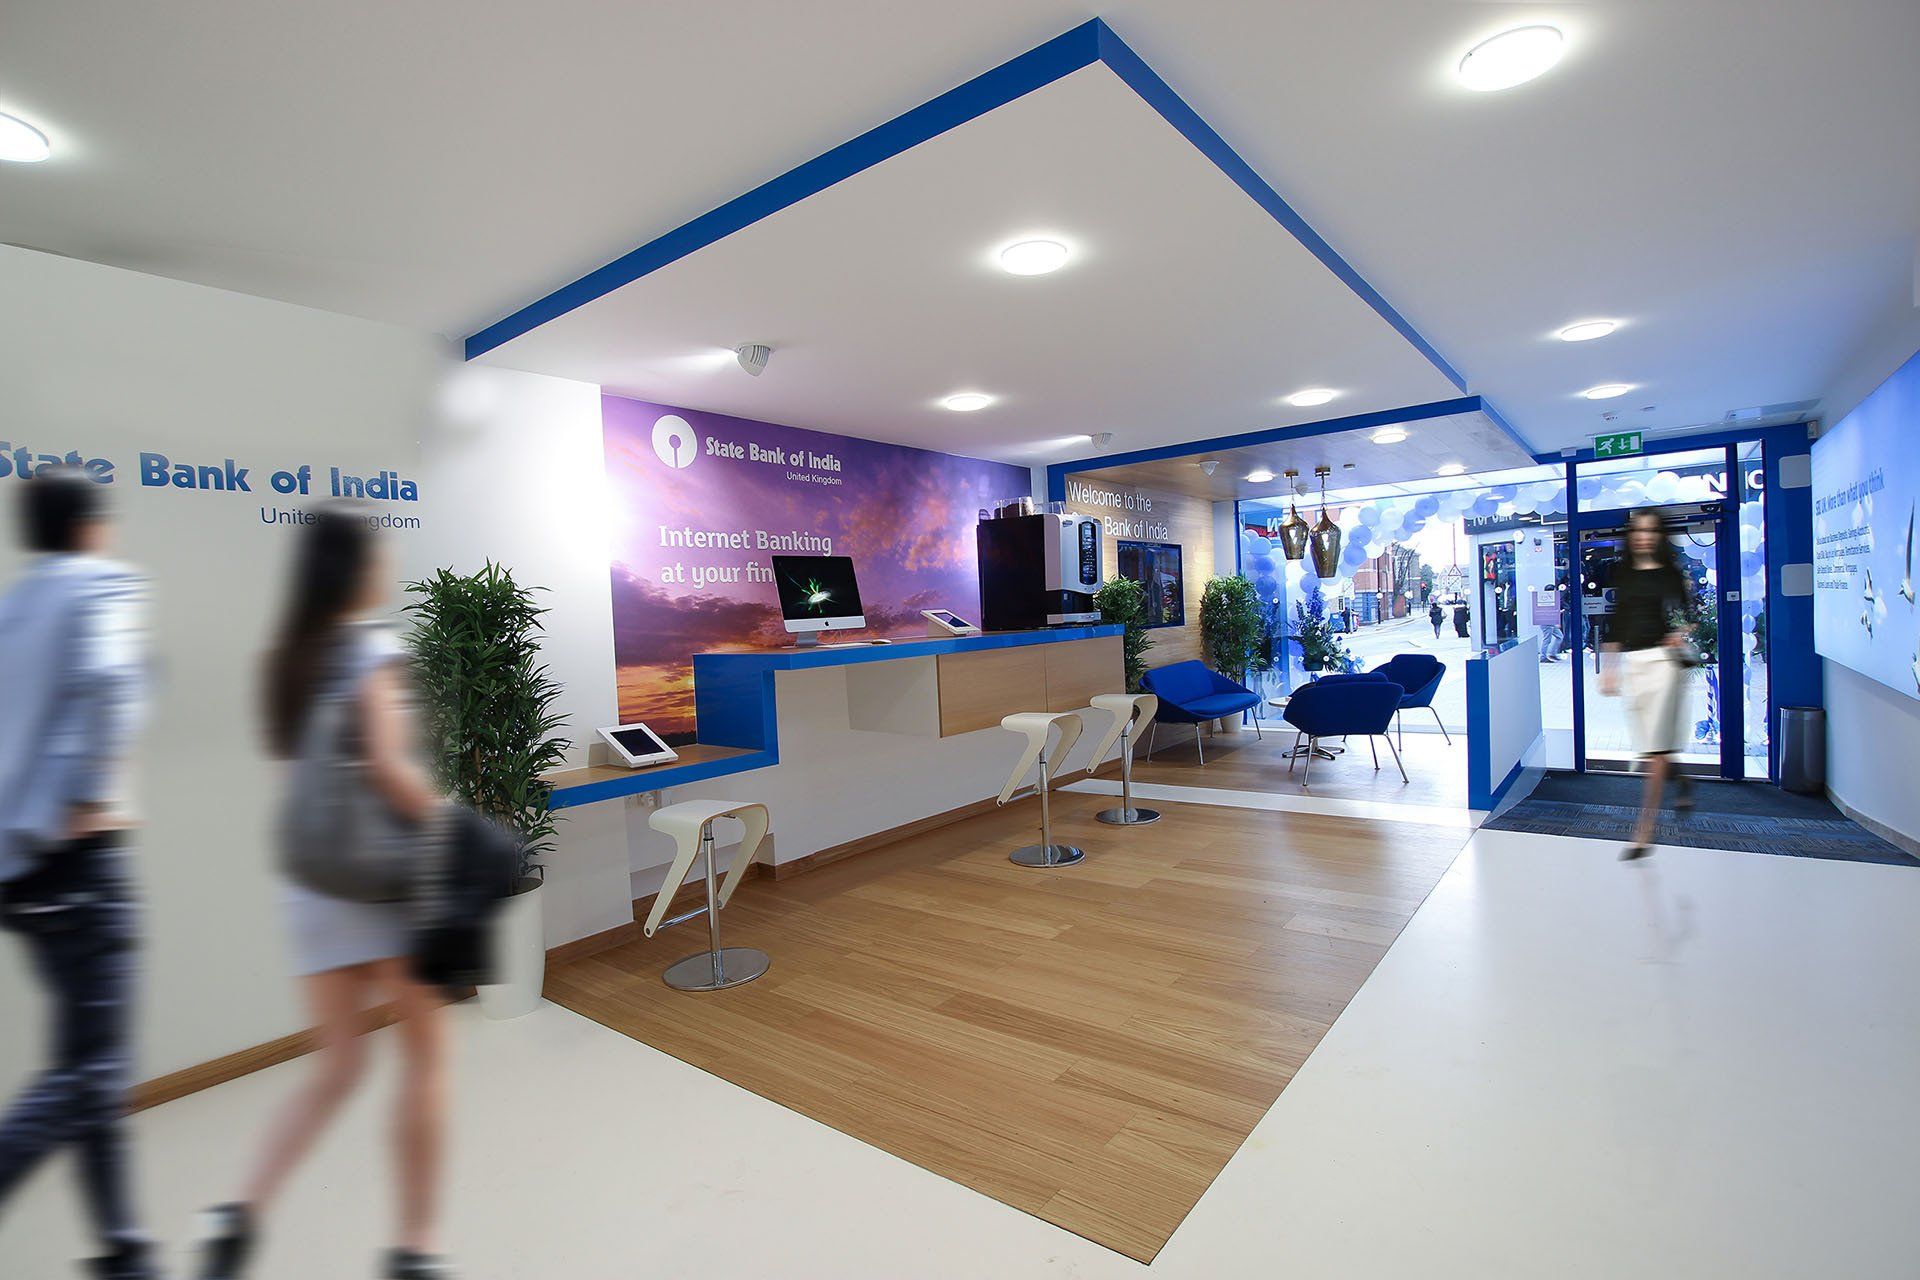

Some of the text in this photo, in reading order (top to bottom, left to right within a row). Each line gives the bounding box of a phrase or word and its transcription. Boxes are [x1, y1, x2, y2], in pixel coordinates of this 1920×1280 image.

[706, 436, 841, 472] State Bank of India
[139, 452, 252, 493] Bank
[270, 465, 311, 495] of
[330, 467, 418, 501] India
[786, 471, 842, 486] United Kingdom
[1068, 481, 1152, 512] Welcome to the
[359, 512, 420, 531] ngdom
[1104, 516, 1168, 540] Bank of India
[658, 525, 832, 556] Internet Banking
[660, 562, 685, 583] at
[691, 566, 740, 589] your
